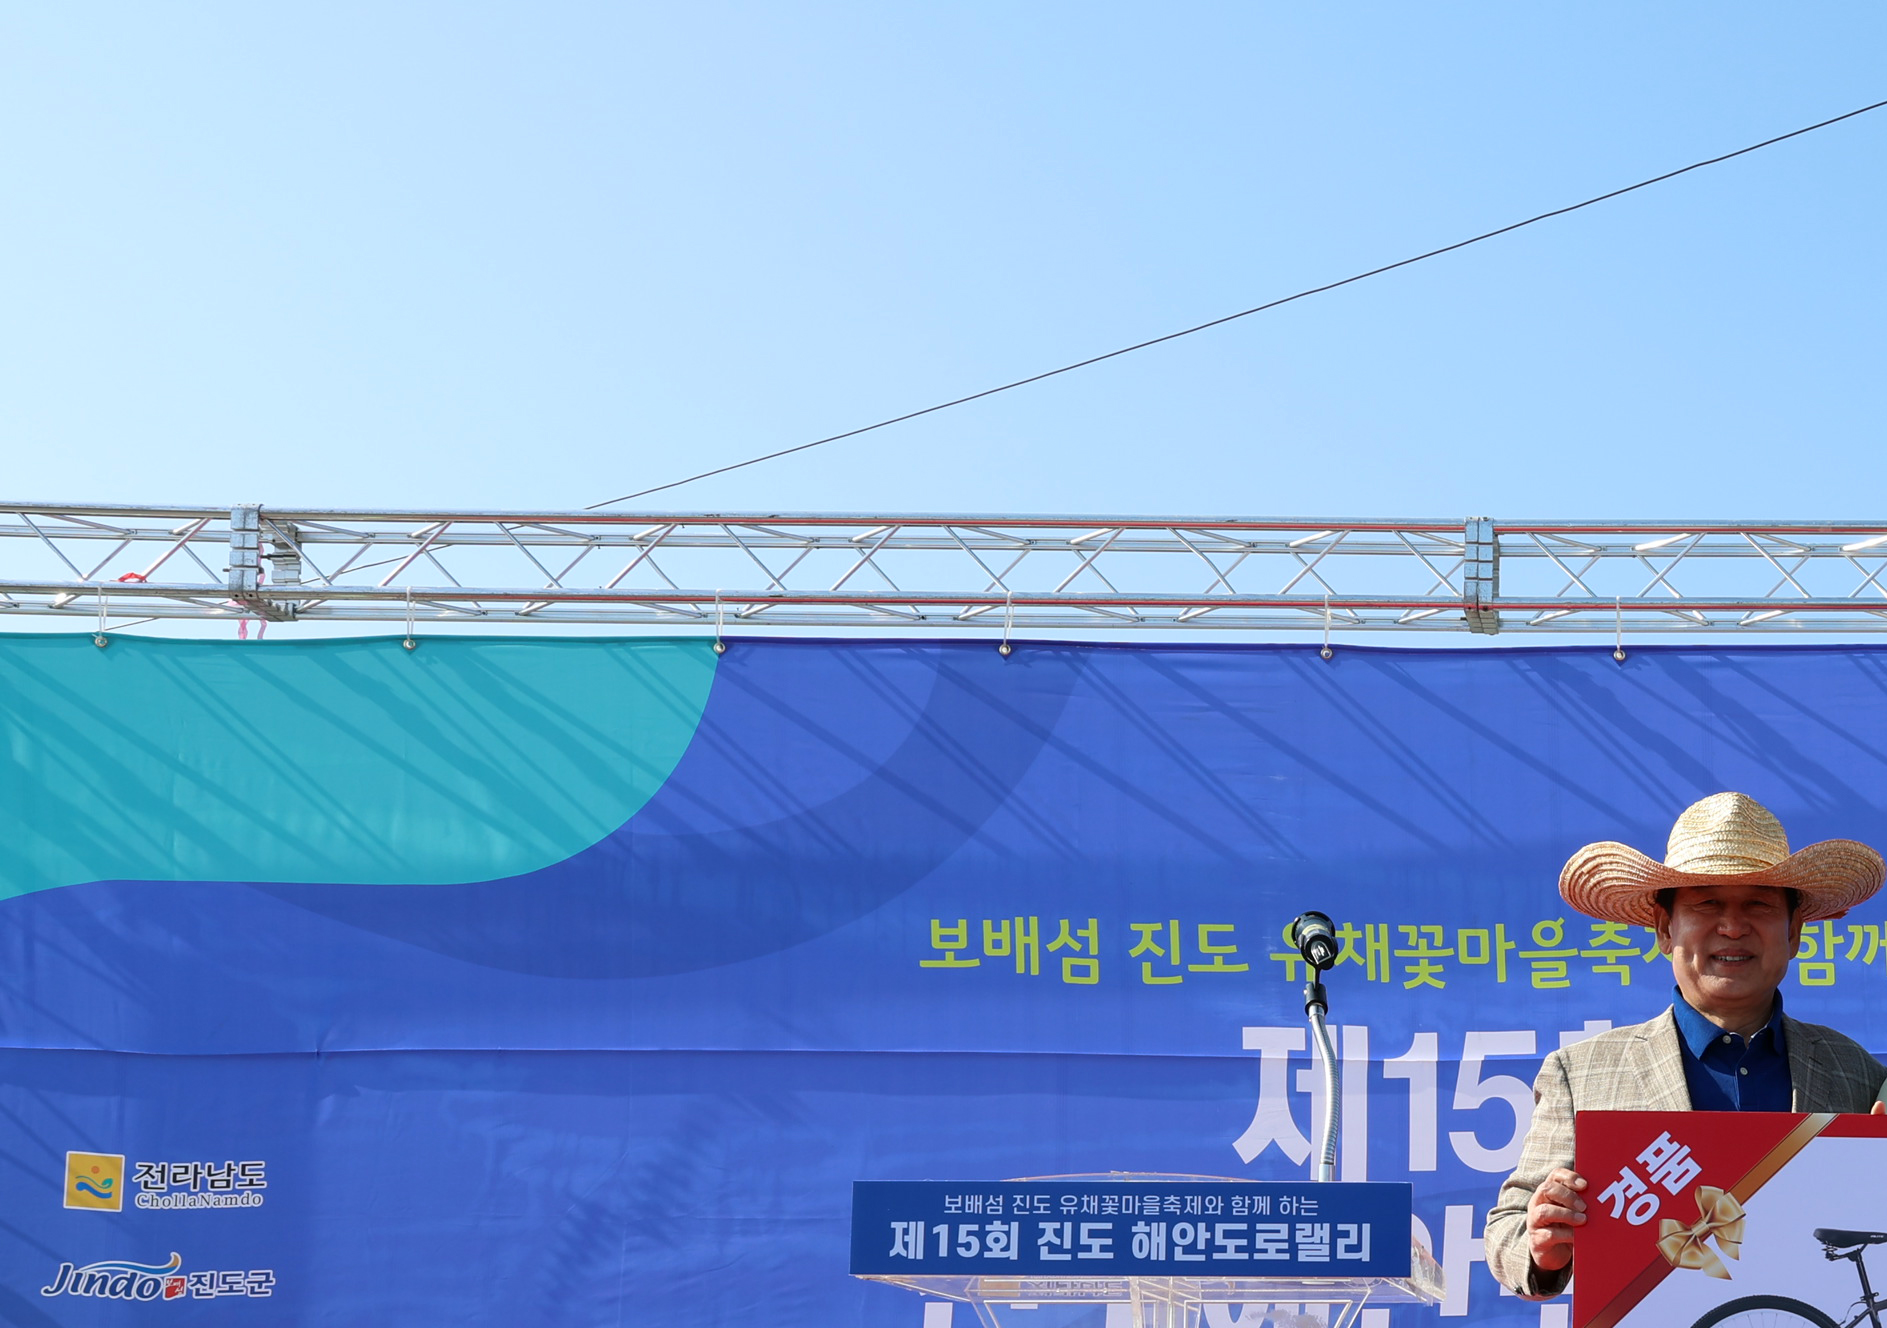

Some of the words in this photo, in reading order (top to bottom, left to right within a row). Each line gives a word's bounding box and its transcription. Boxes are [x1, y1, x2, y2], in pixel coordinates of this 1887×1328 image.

[919, 915, 1100, 985] 보배섬
[1128, 919, 1249, 985] 진도
[1270, 917, 1674, 989] 유채꽃마을축
[1232, 1020, 1613, 1182] 제15
[134, 1162, 266, 1190] 전라남도
[1597, 1130, 1703, 1227] 경품
[136, 1193, 262, 1208] ChollaNamdo
[944, 1195, 1004, 1216] 보배섬
[1013, 1195, 1051, 1216] 진도
[1059, 1194, 1225, 1217] 유채꽃마을축제와
[1231, 1195, 1271, 1217] 함께
[1279, 1195, 1319, 1217] 하는
[889, 1220, 1020, 1262] 제15회
[1037, 1221, 1115, 1262] 진도
[1131, 1221, 1371, 1264] 해안도로랠리
[43, 1264, 162, 1299] Jindo
[189, 1272, 275, 1297] 진도군
